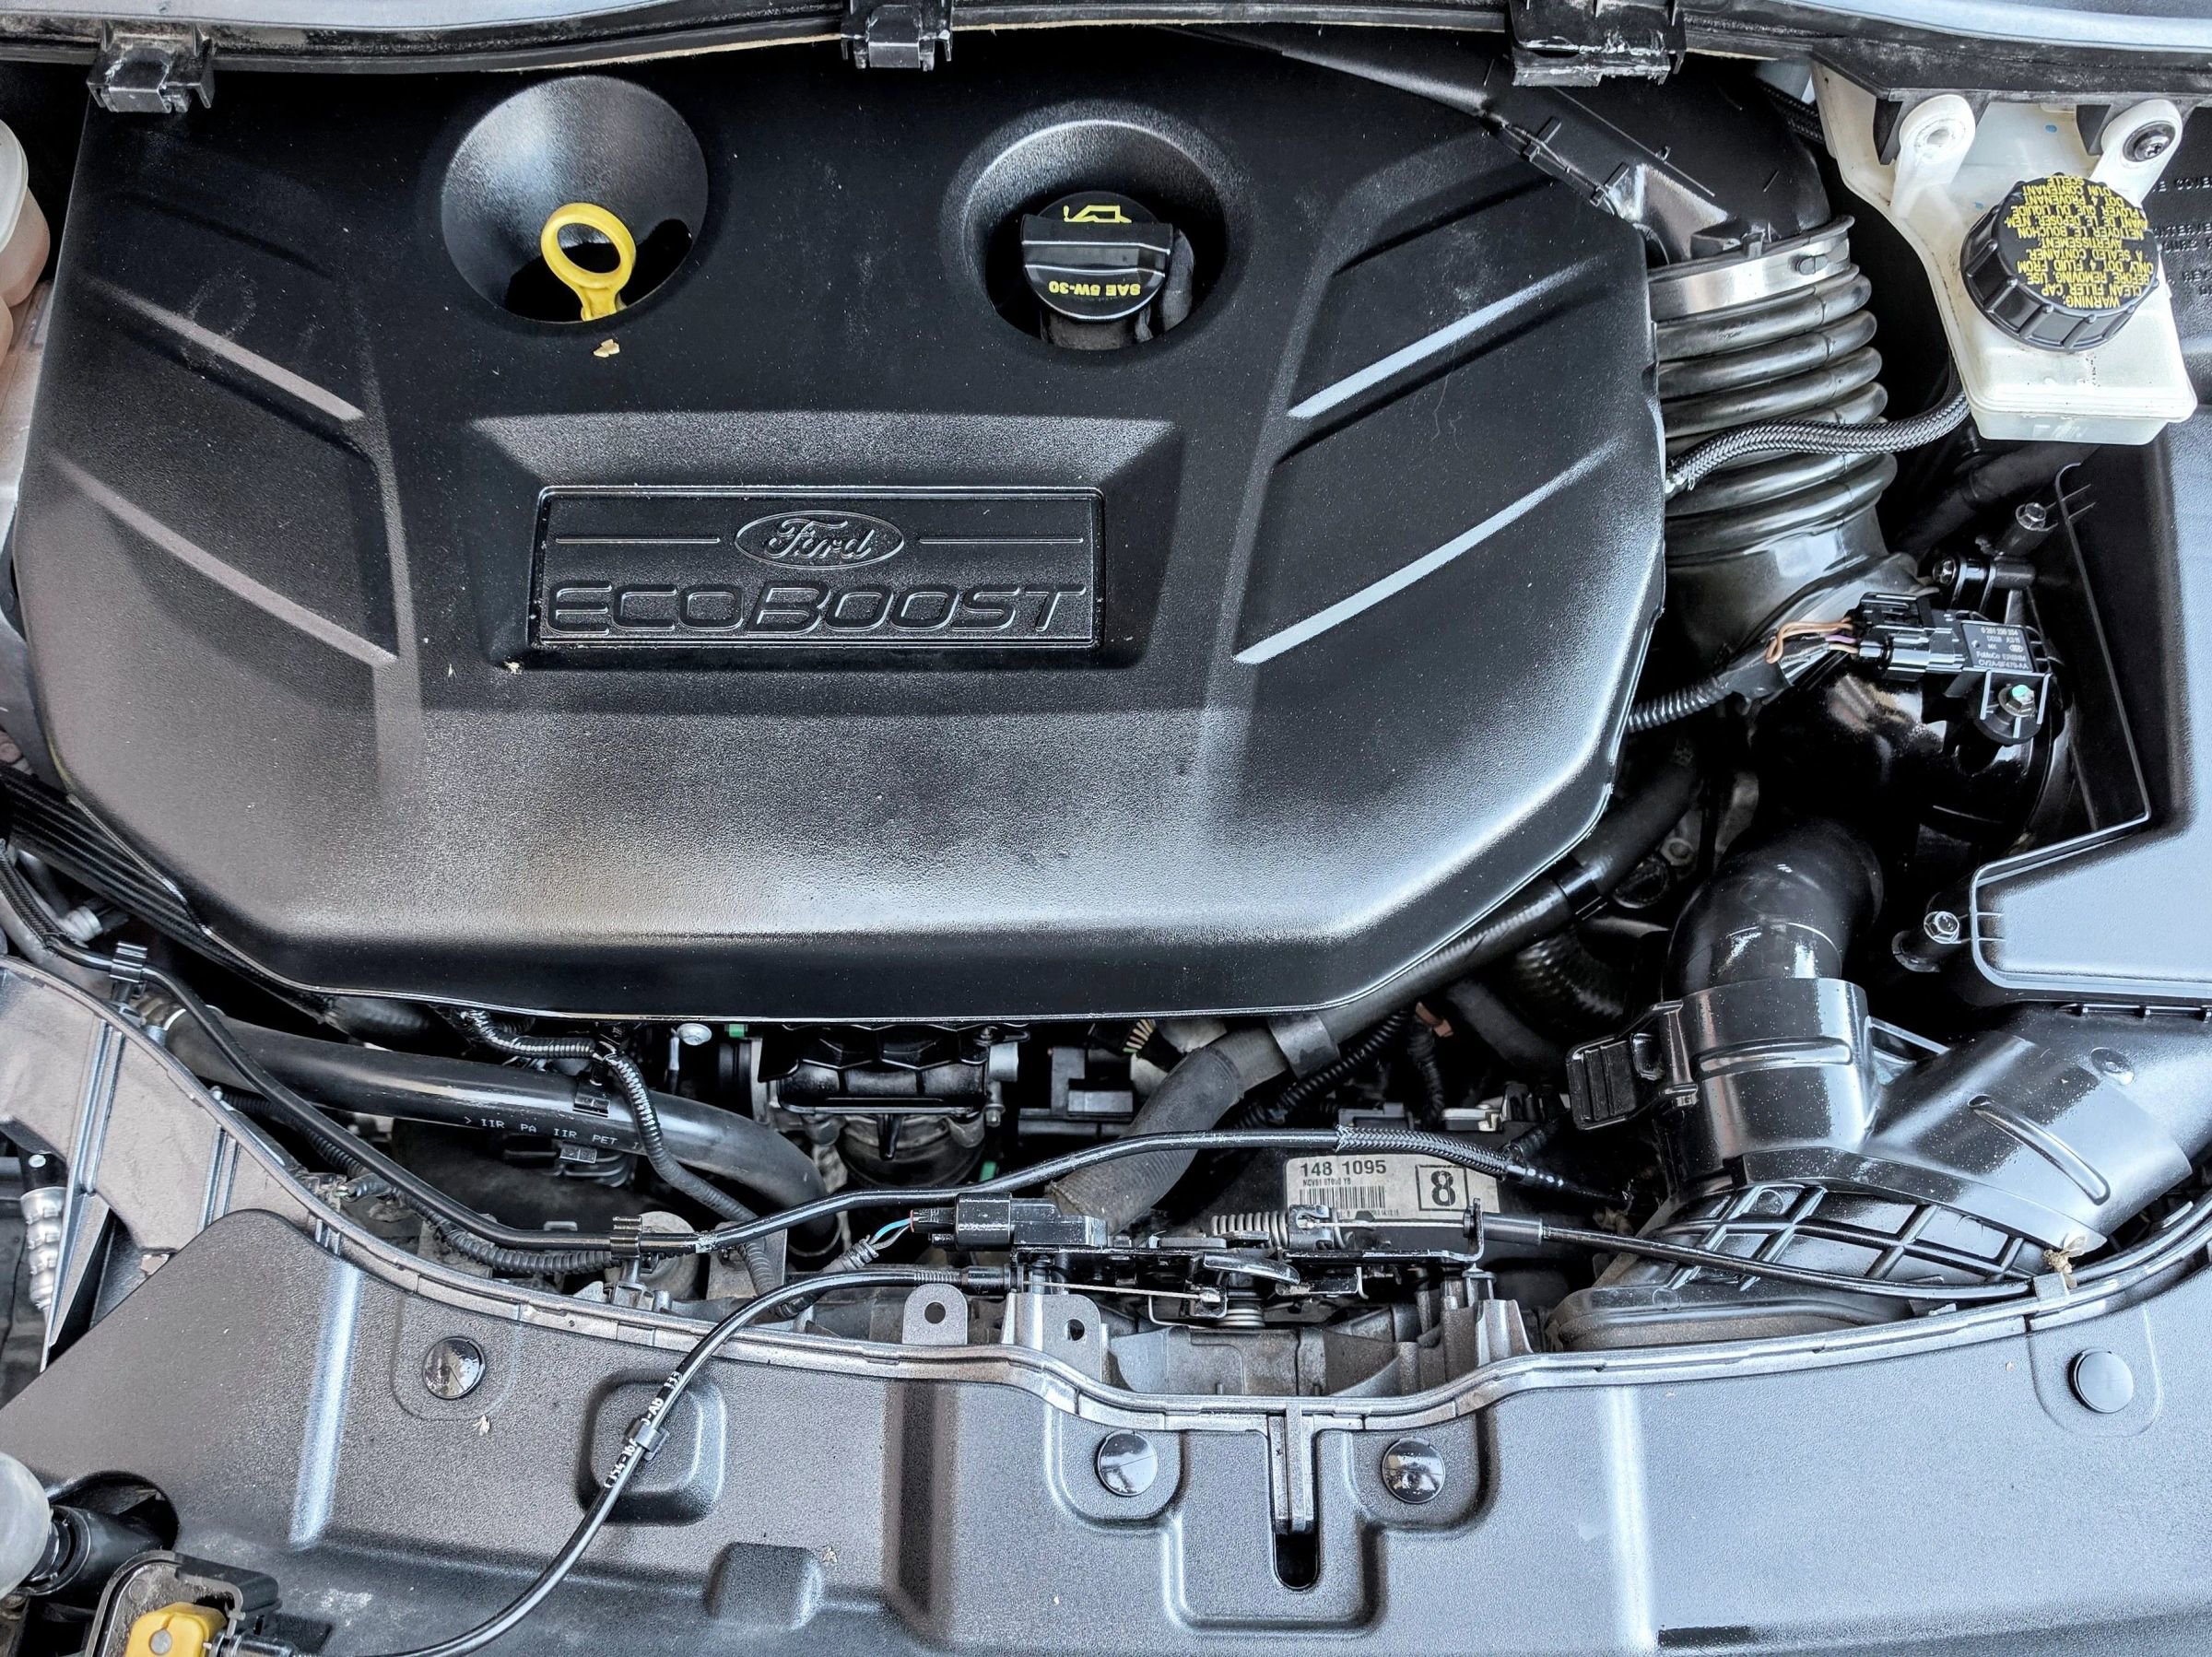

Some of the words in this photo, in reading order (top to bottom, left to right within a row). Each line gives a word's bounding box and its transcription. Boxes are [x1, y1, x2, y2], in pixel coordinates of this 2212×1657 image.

[2022, 184, 2083, 196] CONTENANT
[2024, 194, 2085, 206] PROVENANT
[2091, 196, 2099, 205] 4
[2105, 196, 2124, 206] DOT
[2010, 206, 2050, 217] LIQUIDE
[2055, 206, 2071, 216] DU
[2072, 206, 2096, 216] QUE
[2100, 206, 2139, 217] PLOYER
[2087, 216, 2098, 227] LE
[2102, 216, 2115, 228] DE
[2120, 217, 2147, 229] AVANT
[2018, 227, 2067, 239] BOUCHON
[2092, 227, 2144, 240] NETTOYER
[2092, 249, 2130, 260] SEALED
[2136, 250, 2143, 259] A
[2018, 261, 2048, 273] FROM
[2053, 260, 2083, 272] FLUID
[2089, 260, 2097, 271] 4
[2103, 261, 2123, 272] DOT
[2129, 261, 2154, 273] ONLY
[2026, 272, 2048, 285] USE
[2112, 272, 2149, 285] BEFORE
[1048, 280, 1101, 297] 5W-30
[1105, 283, 1142, 297] SAE
[2041, 284, 2063, 296] CAP
[2069, 284, 2103, 296] FILLER
[2109, 284, 2142, 296] CLEAN
[765, 516, 876, 561] Ford
[480, 1118, 505, 1129] IIR
[520, 1123, 537, 1133] PA
[554, 1128, 578, 1139] IIR
[592, 1134, 618, 1146] PET
[1300, 1161, 1333, 1178] 148
[1342, 1159, 1387, 1175] 1095
[1430, 1169, 1456, 1207] 8
